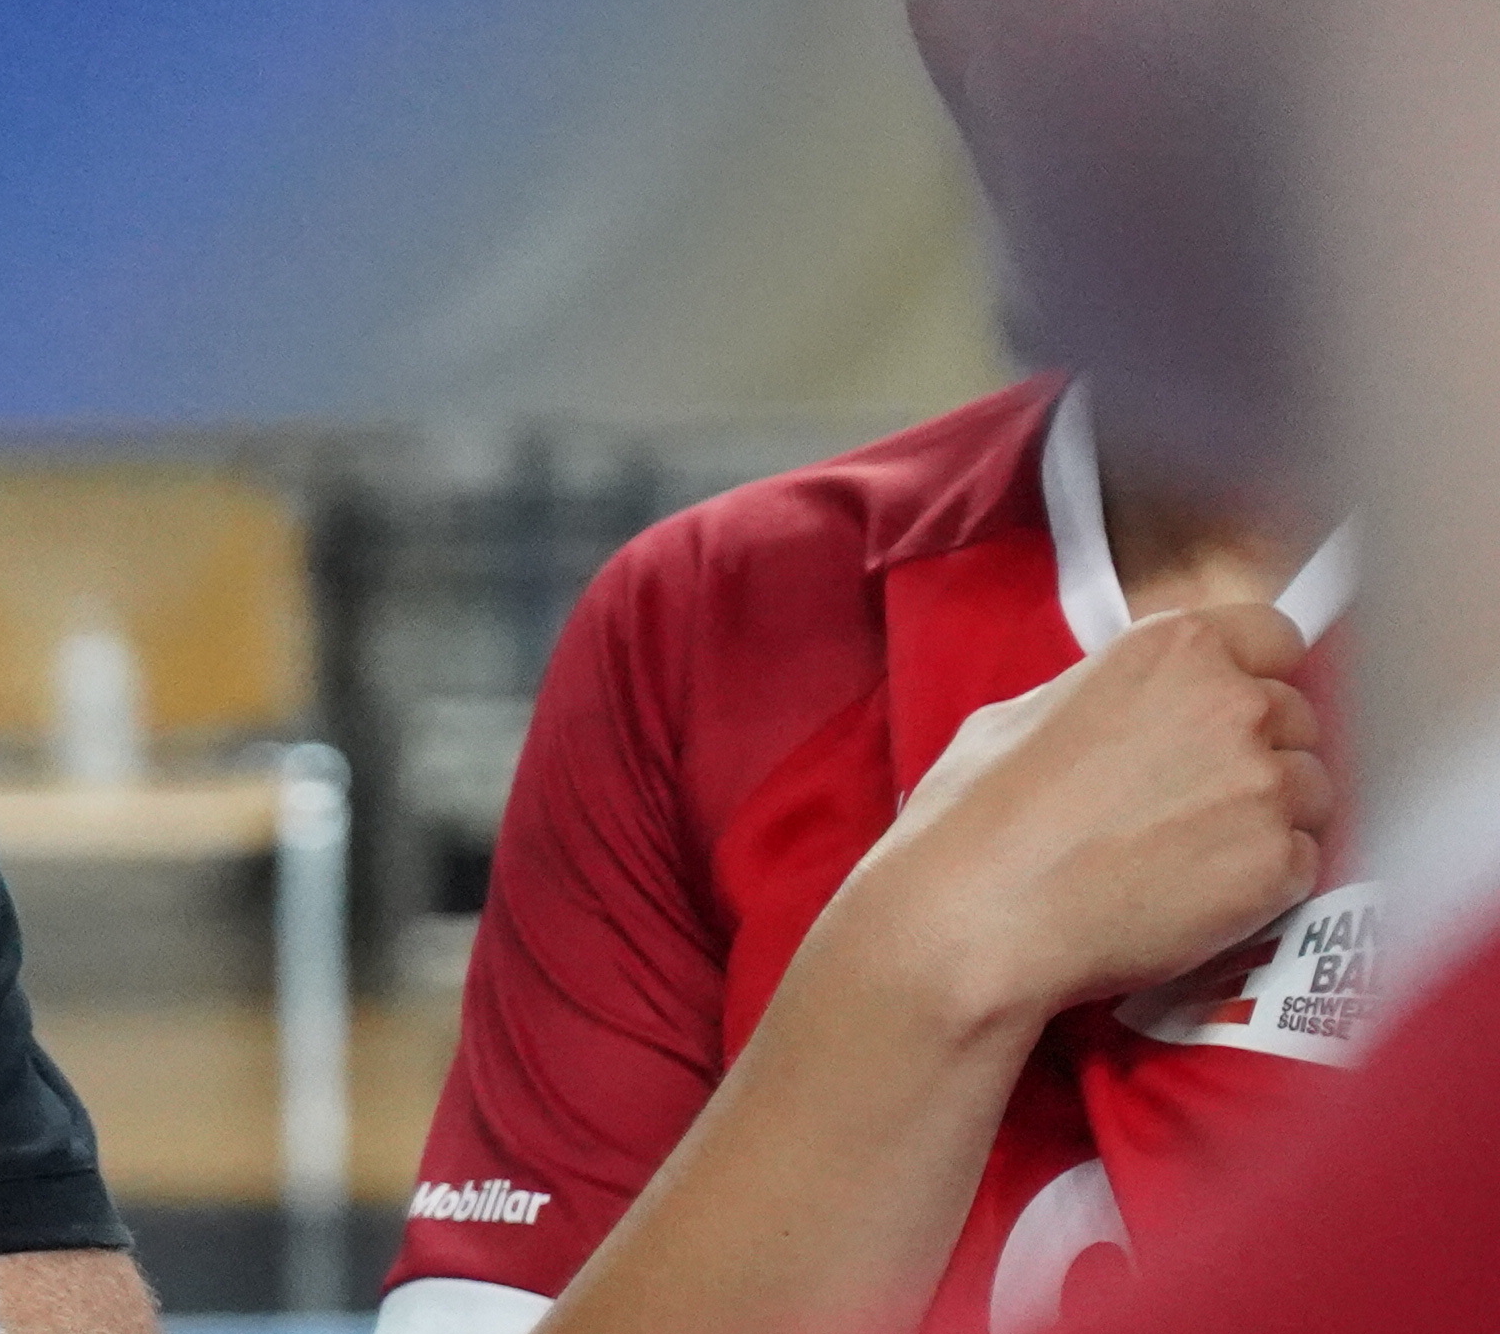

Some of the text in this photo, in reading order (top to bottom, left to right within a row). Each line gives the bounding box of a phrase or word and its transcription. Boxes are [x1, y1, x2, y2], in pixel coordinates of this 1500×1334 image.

[1298, 905, 1379, 958] HAN
[1277, 1012, 1350, 1040] SUISSE
[1282, 996, 1368, 1020] SCHWE
[409, 1178, 551, 1225] Mobiliar
